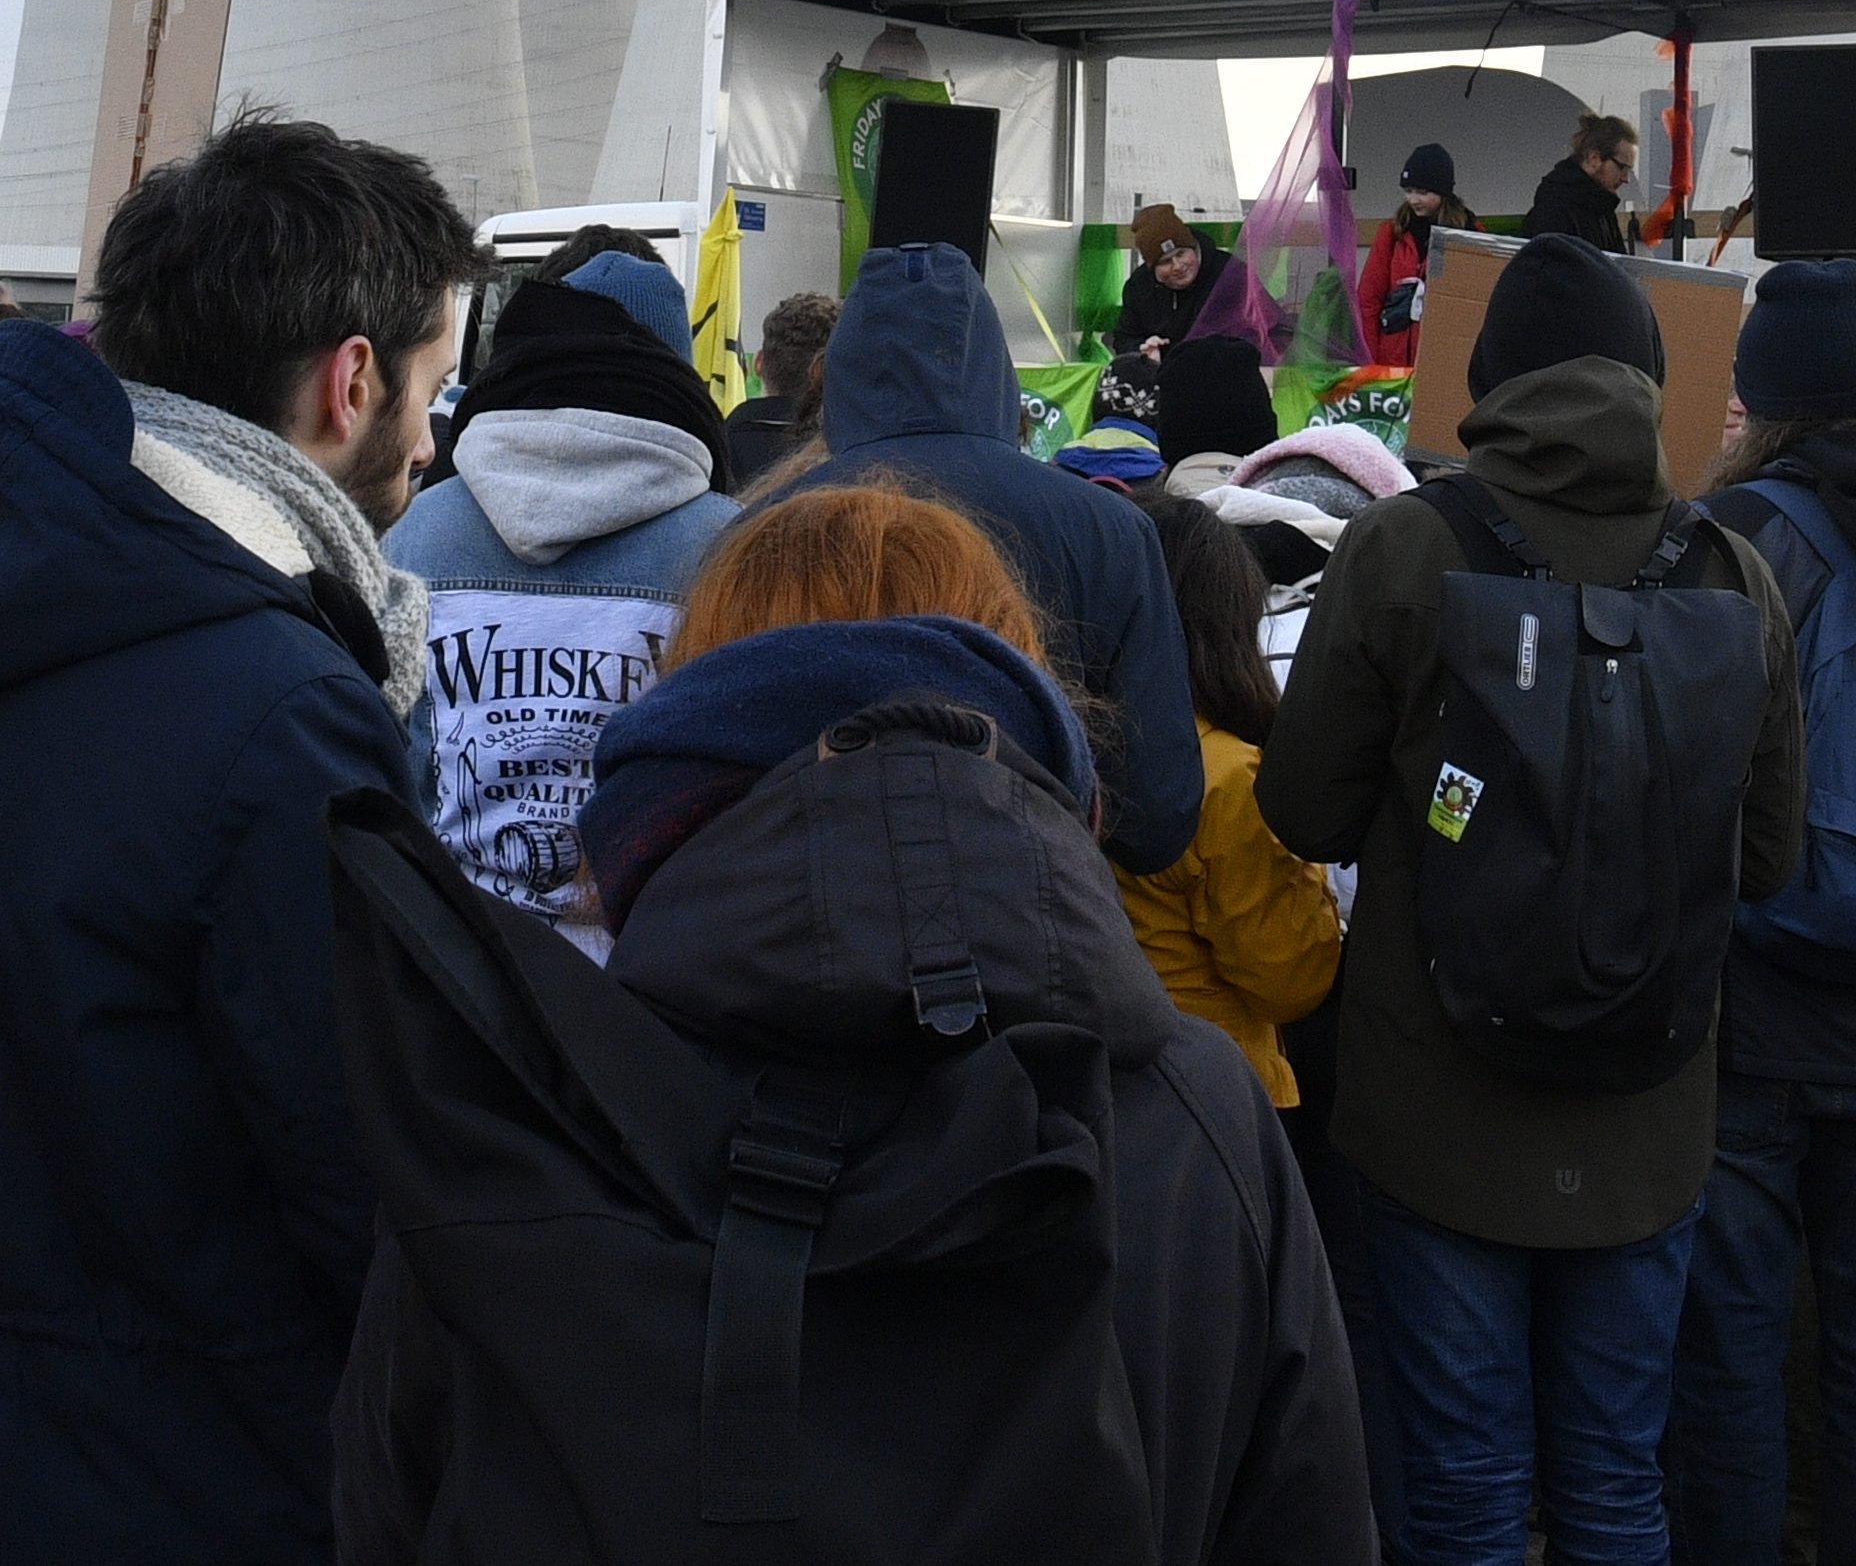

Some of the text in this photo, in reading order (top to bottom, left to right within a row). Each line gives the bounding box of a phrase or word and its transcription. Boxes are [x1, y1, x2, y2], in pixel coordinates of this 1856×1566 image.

[486, 708, 536, 724] OLD
[497, 759, 593, 779] BEST
[483, 783, 593, 806] QUALIT
[516, 802, 571, 819] BRAND
